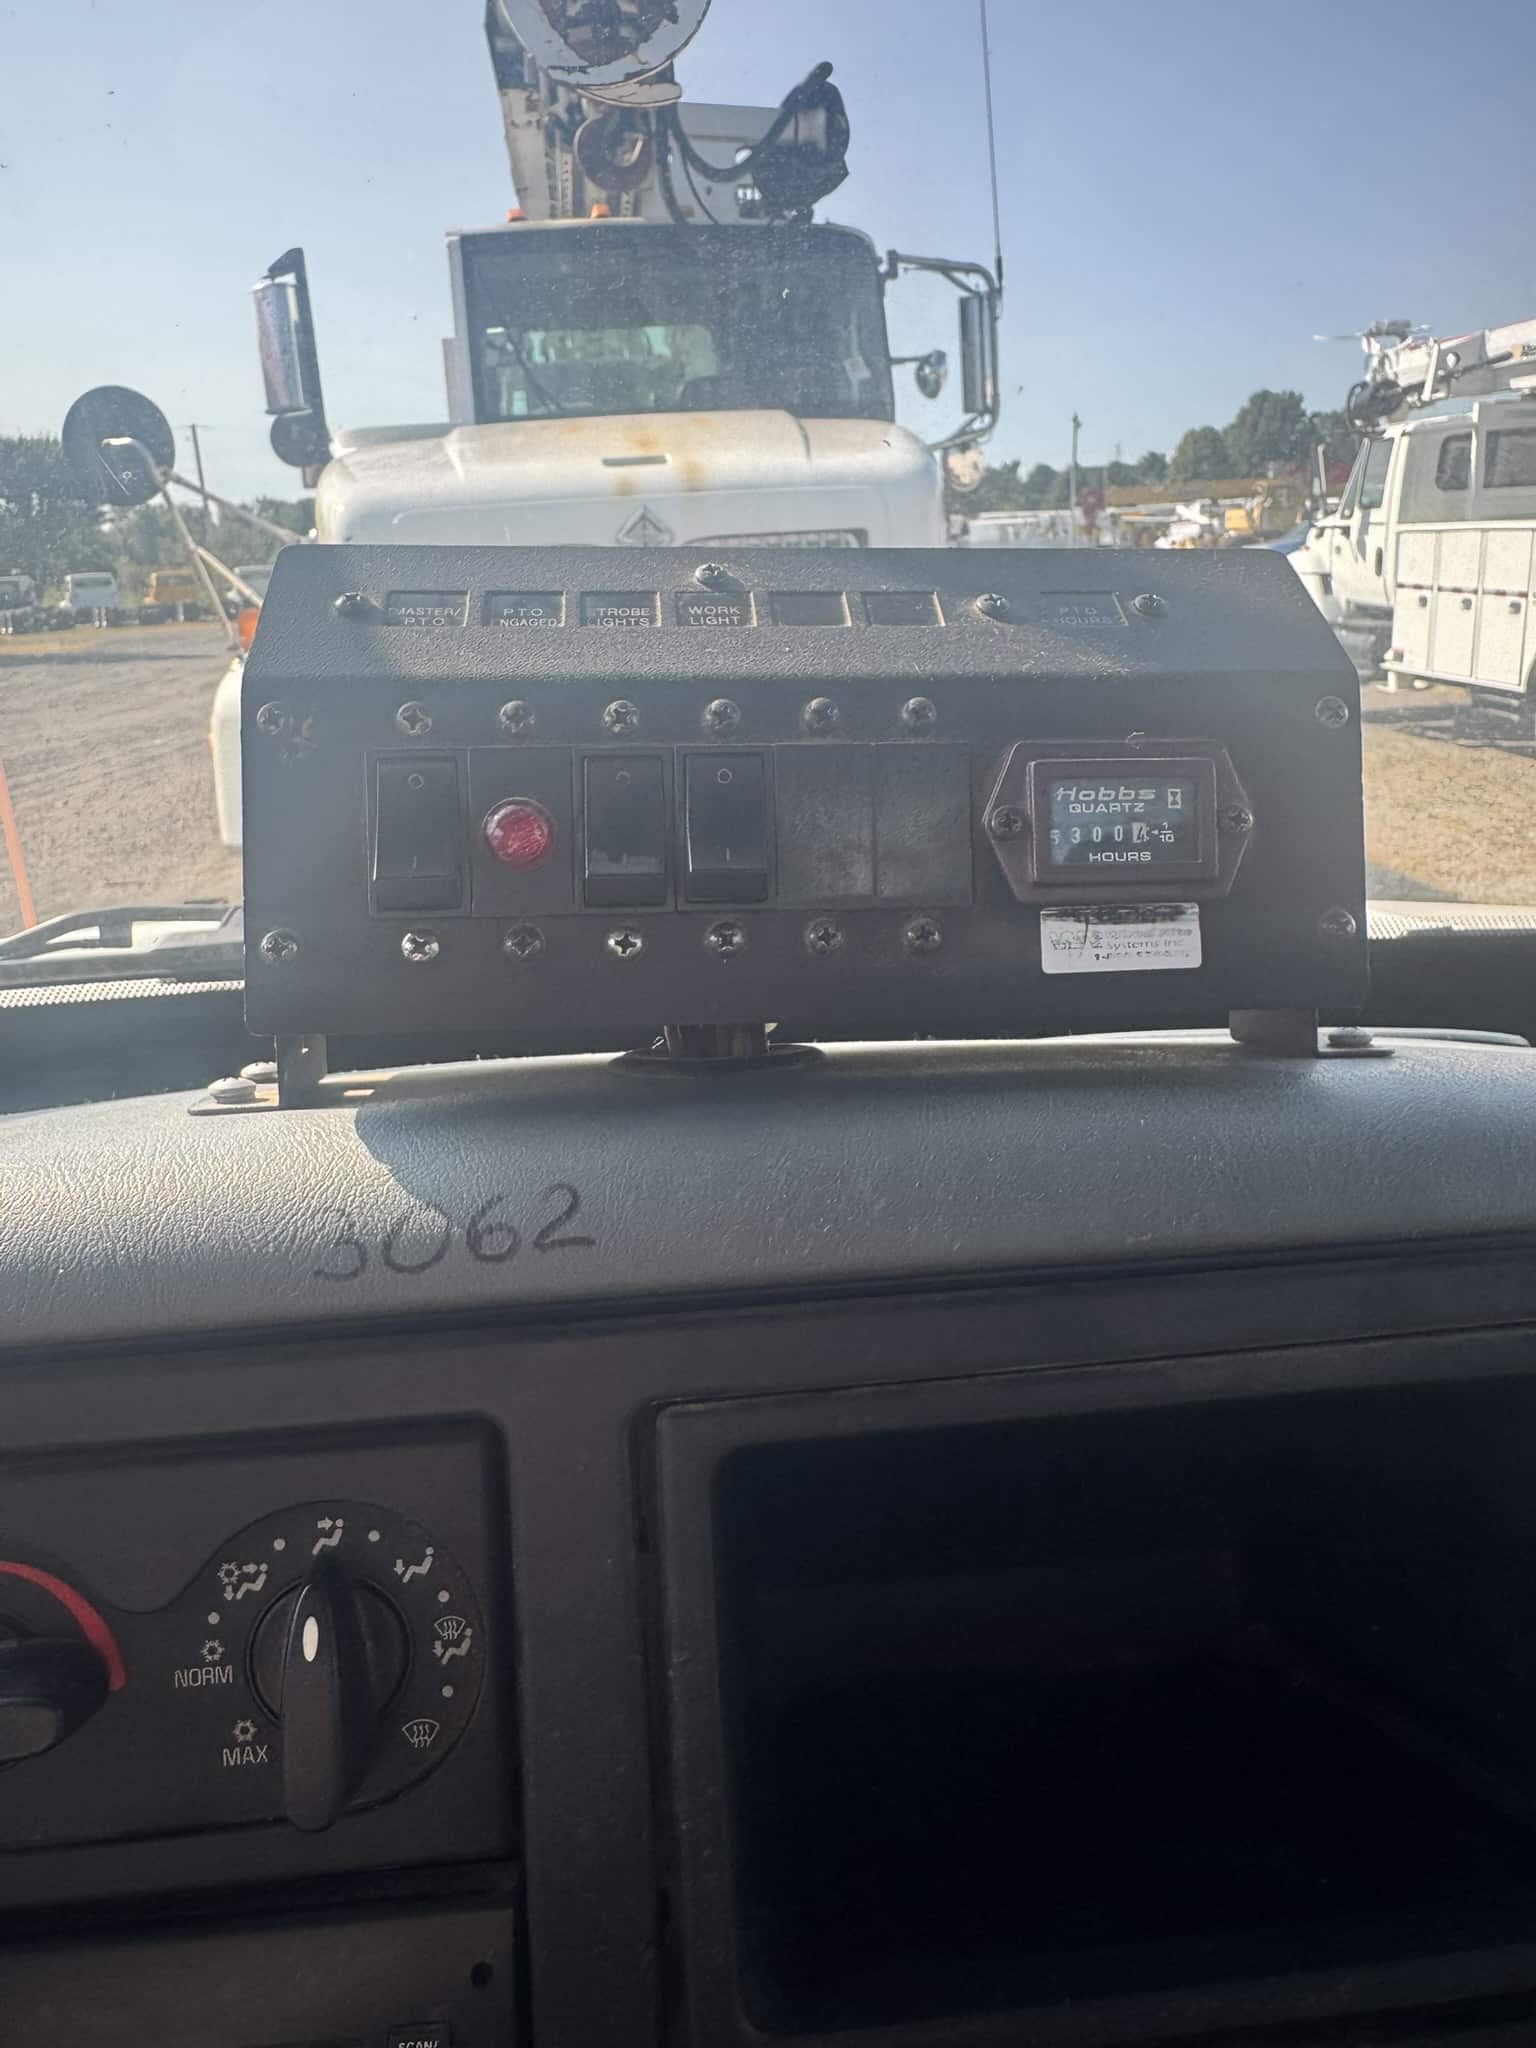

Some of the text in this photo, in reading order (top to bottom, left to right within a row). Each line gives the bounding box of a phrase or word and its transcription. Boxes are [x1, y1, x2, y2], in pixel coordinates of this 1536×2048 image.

[595, 607, 651, 617] TROBE
[687, 605, 741, 616] WORK
[689, 615, 738, 625] LIGHT
[1055, 786, 1156, 801] Hobbs
[1068, 802, 1145, 814] QUARTZ
[1088, 851, 1152, 862] HOURS
[174, 1664, 233, 1689] NORM
[222, 1744, 269, 1767] MAX
